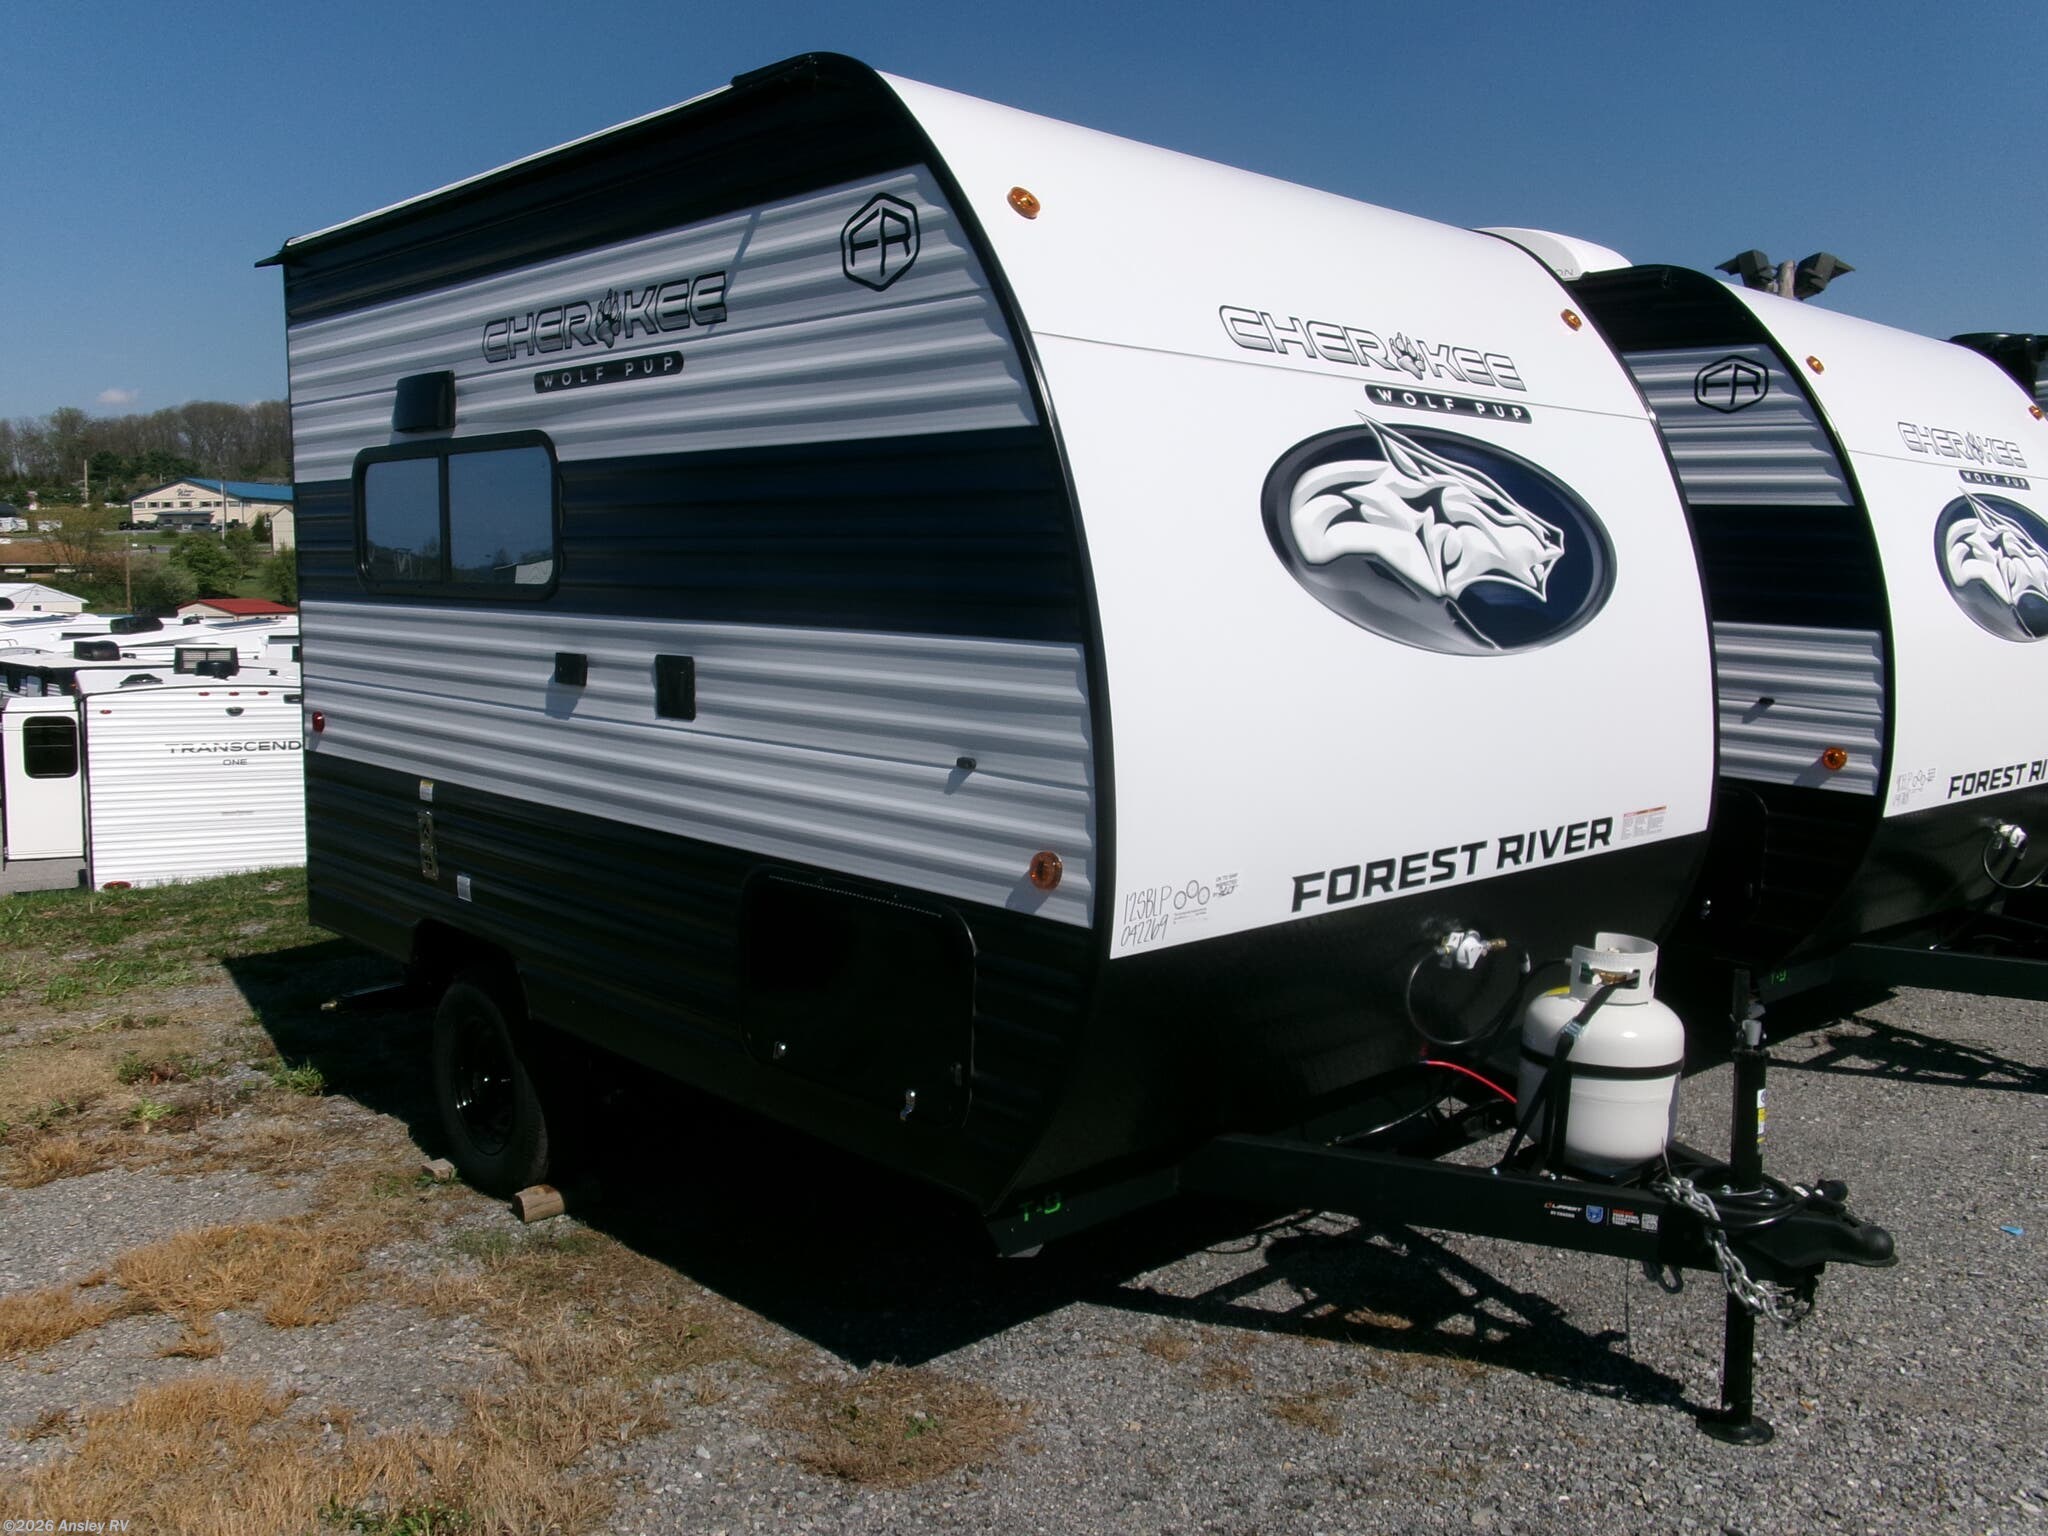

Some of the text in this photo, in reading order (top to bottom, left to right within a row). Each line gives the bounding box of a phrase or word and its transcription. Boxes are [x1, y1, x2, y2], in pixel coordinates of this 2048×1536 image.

[541, 356, 674, 388] WOLF PUP
[1376, 388, 1523, 420] WOLF PUP
[1962, 471, 2027, 488] WOLF PUP
[165, 740, 302, 754] TRANSCEND
[222, 758, 249, 766] ONE
[1947, 763, 2028, 800] FOREST
[1290, 840, 1488, 914] FOREST
[1496, 816, 1614, 870] RIVER
